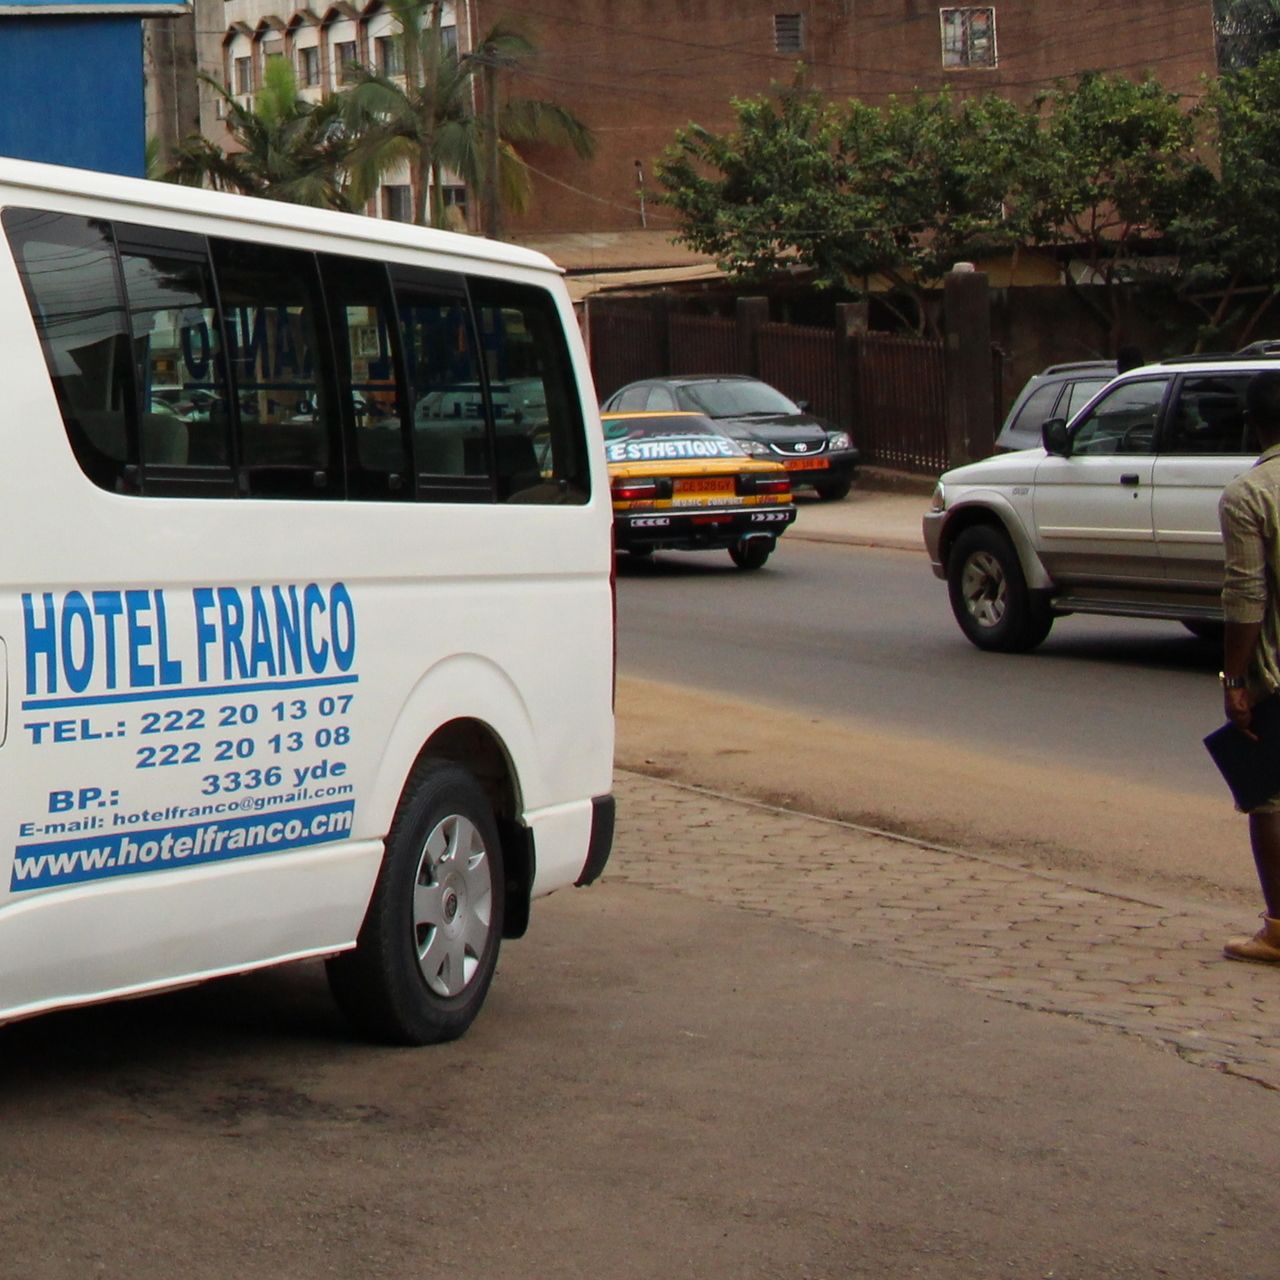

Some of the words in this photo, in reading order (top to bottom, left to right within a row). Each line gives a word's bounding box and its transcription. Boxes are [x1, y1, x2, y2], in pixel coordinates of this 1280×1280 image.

[610, 439, 733, 461] ESTHETIQUE
[671, 498, 702, 507] MUSIC
[20, 589, 182, 695] HOTEL
[192, 582, 356, 682] FRANCO
[23, 718, 126, 745] TEL.:
[140, 709, 206, 735] 222
[218, 704, 259, 727] 20
[271, 699, 307, 721] 13
[318, 694, 354, 717] 07
[135, 742, 202, 769] 222
[213, 738, 255, 762] 20
[268, 731, 303, 754] 13
[315, 726, 351, 748] 08
[19, 816, 105, 838] E-mail:
[112, 784, 353, 826] hotelfranco@gmail.com
[48, 787, 119, 814] BP.:
[201, 766, 282, 796] 3336
[293, 759, 347, 787] yde
[13, 809, 353, 881] www.hotelfranco.cm
